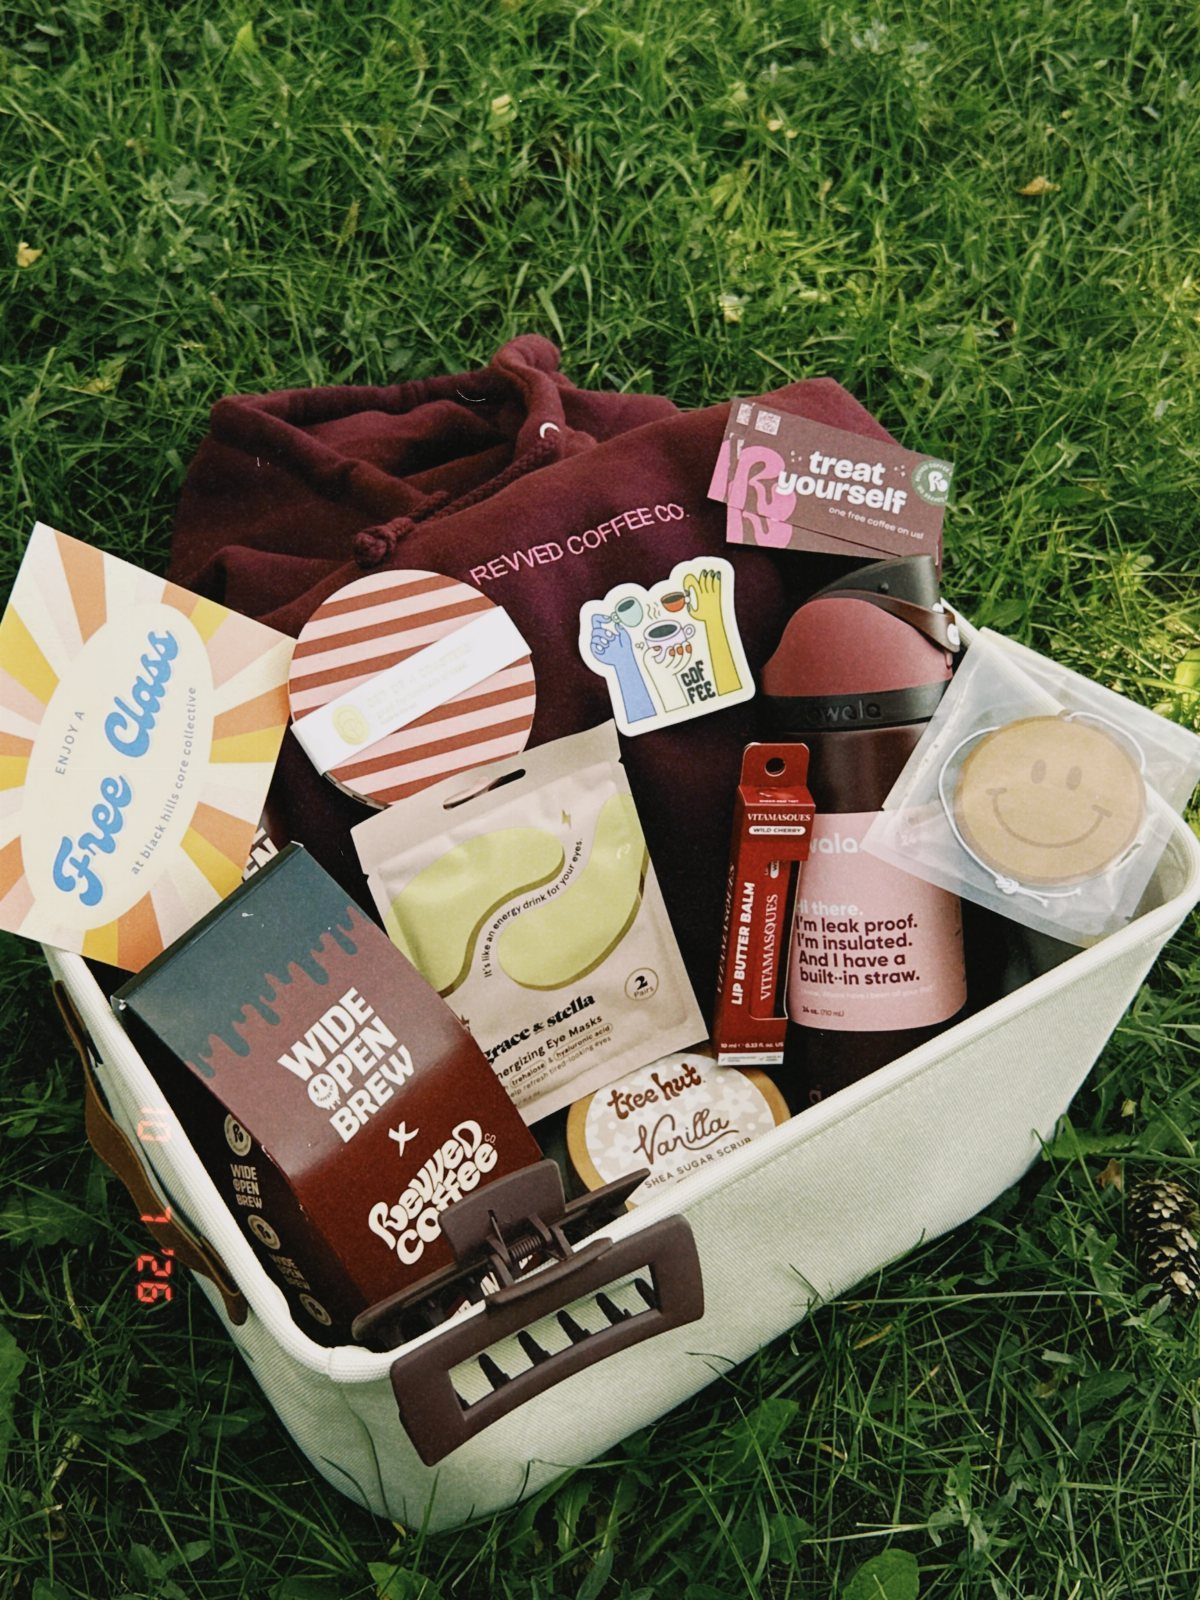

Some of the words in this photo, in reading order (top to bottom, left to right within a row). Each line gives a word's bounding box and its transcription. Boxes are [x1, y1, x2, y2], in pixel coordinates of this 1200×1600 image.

[809, 450, 886, 486] treat
[775, 471, 908, 515] yourself
[829, 507, 846, 517] one
[847, 511, 866, 523] free
[867, 518, 896, 531] coffee
[897, 527, 909, 536] on
[469, 542, 564, 586] REVVED
[566, 507, 655, 555] COFFEE
[655, 503, 690, 522] CO.
[680, 660, 705, 687] COF
[687, 680, 716, 704] FEE
[55, 723, 77, 776] ENJOY
[76, 710, 86, 721] A
[52, 774, 133, 907] Free
[104, 629, 180, 759] Class
[131, 861, 145, 876] at
[140, 825, 166, 860] black
[161, 792, 179, 823] hills
[175, 759, 189, 790] core
[183, 686, 197, 757] collective
[747, 813, 811, 822] VITAMASQUES
[572, 838, 583, 863] eyes.
[559, 864, 575, 886] your
[522, 894, 547, 910] drink
[547, 884, 561, 897] for
[740, 881, 756, 924] BALM
[493, 905, 521, 930] energy
[811, 901, 864, 917] there.
[486, 930, 496, 943] an
[795, 915, 817, 932] I'm
[821, 917, 859, 933] leak
[864, 913, 918, 936] proof.
[481, 944, 491, 962] like
[733, 926, 751, 980] BUTTER
[760, 893, 779, 1001] VITAMASQUES
[796, 932, 819, 949] I'm
[822, 932, 913, 950] insulated.
[482, 959, 493, 978] It's
[799, 950, 829, 967] And
[833, 953, 838, 967] I
[843, 953, 889, 968] have
[893, 953, 906, 965] a
[635, 975, 648, 991] 2
[864, 969, 920, 985] straw.
[731, 982, 744, 1005] LIP
[276, 986, 375, 1082] WIDE
[484, 1028, 531, 1065] grace
[533, 1022, 545, 1034] &
[546, 993, 596, 1028] stella
[496, 1046, 546, 1079] nergizing
[546, 1034, 566, 1050] Eye
[568, 1015, 604, 1038] Masks
[511, 1062, 546, 1086] trehalose
[556, 1036, 593, 1059] hyaluronic
[594, 1025, 611, 1038] acid
[307, 1015, 398, 1111] OPEN
[328, 1044, 415, 1144] BREW
[606, 1087, 660, 1120] tree
[650, 1062, 702, 1100] hut
[633, 1108, 739, 1166] Vanilla
[230, 1163, 258, 1181] WIDE
[644, 1172, 674, 1189] SHEA
[676, 1153, 714, 1175] SUGAR
[235, 1193, 263, 1210] BREW
